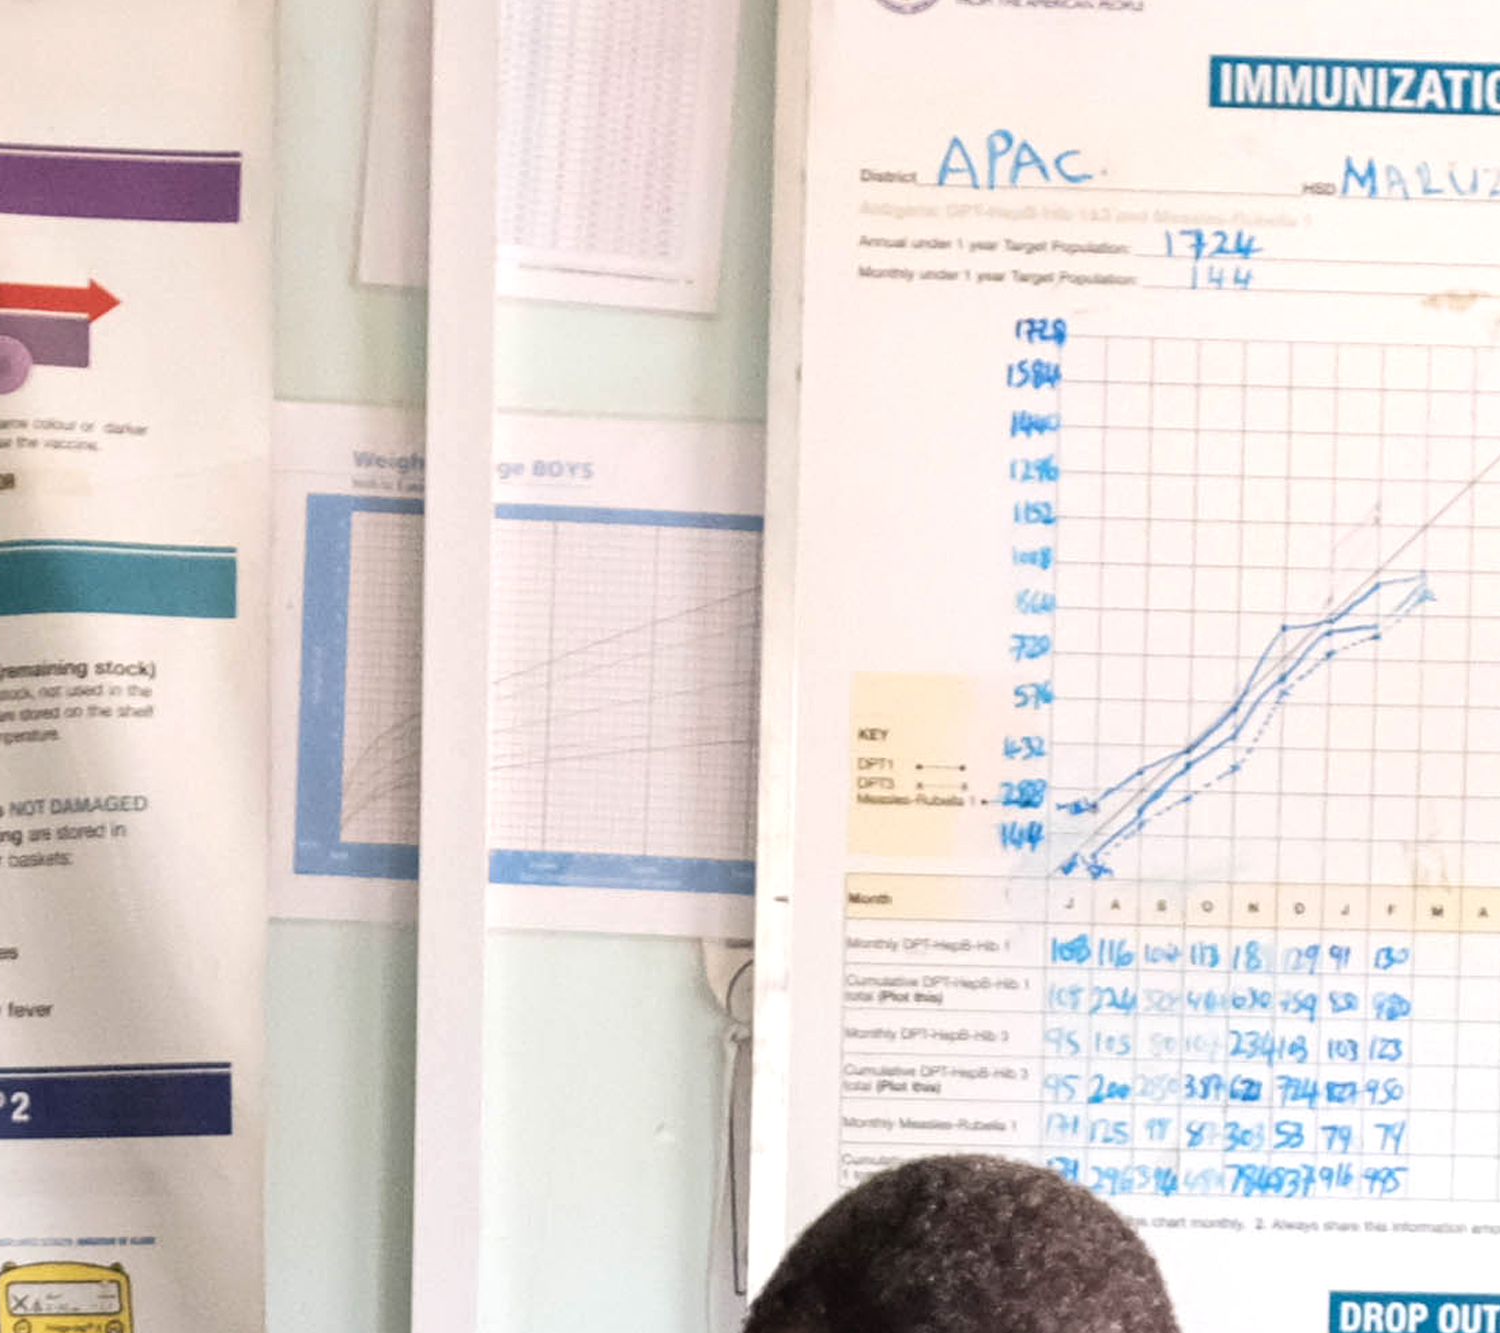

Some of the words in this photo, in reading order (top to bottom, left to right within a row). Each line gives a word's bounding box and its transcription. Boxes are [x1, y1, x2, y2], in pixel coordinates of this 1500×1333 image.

[1167, 231, 1263, 259] 1724
[8, 1002, 53, 1018] fever
[11, 1092, 29, 1122] 2
